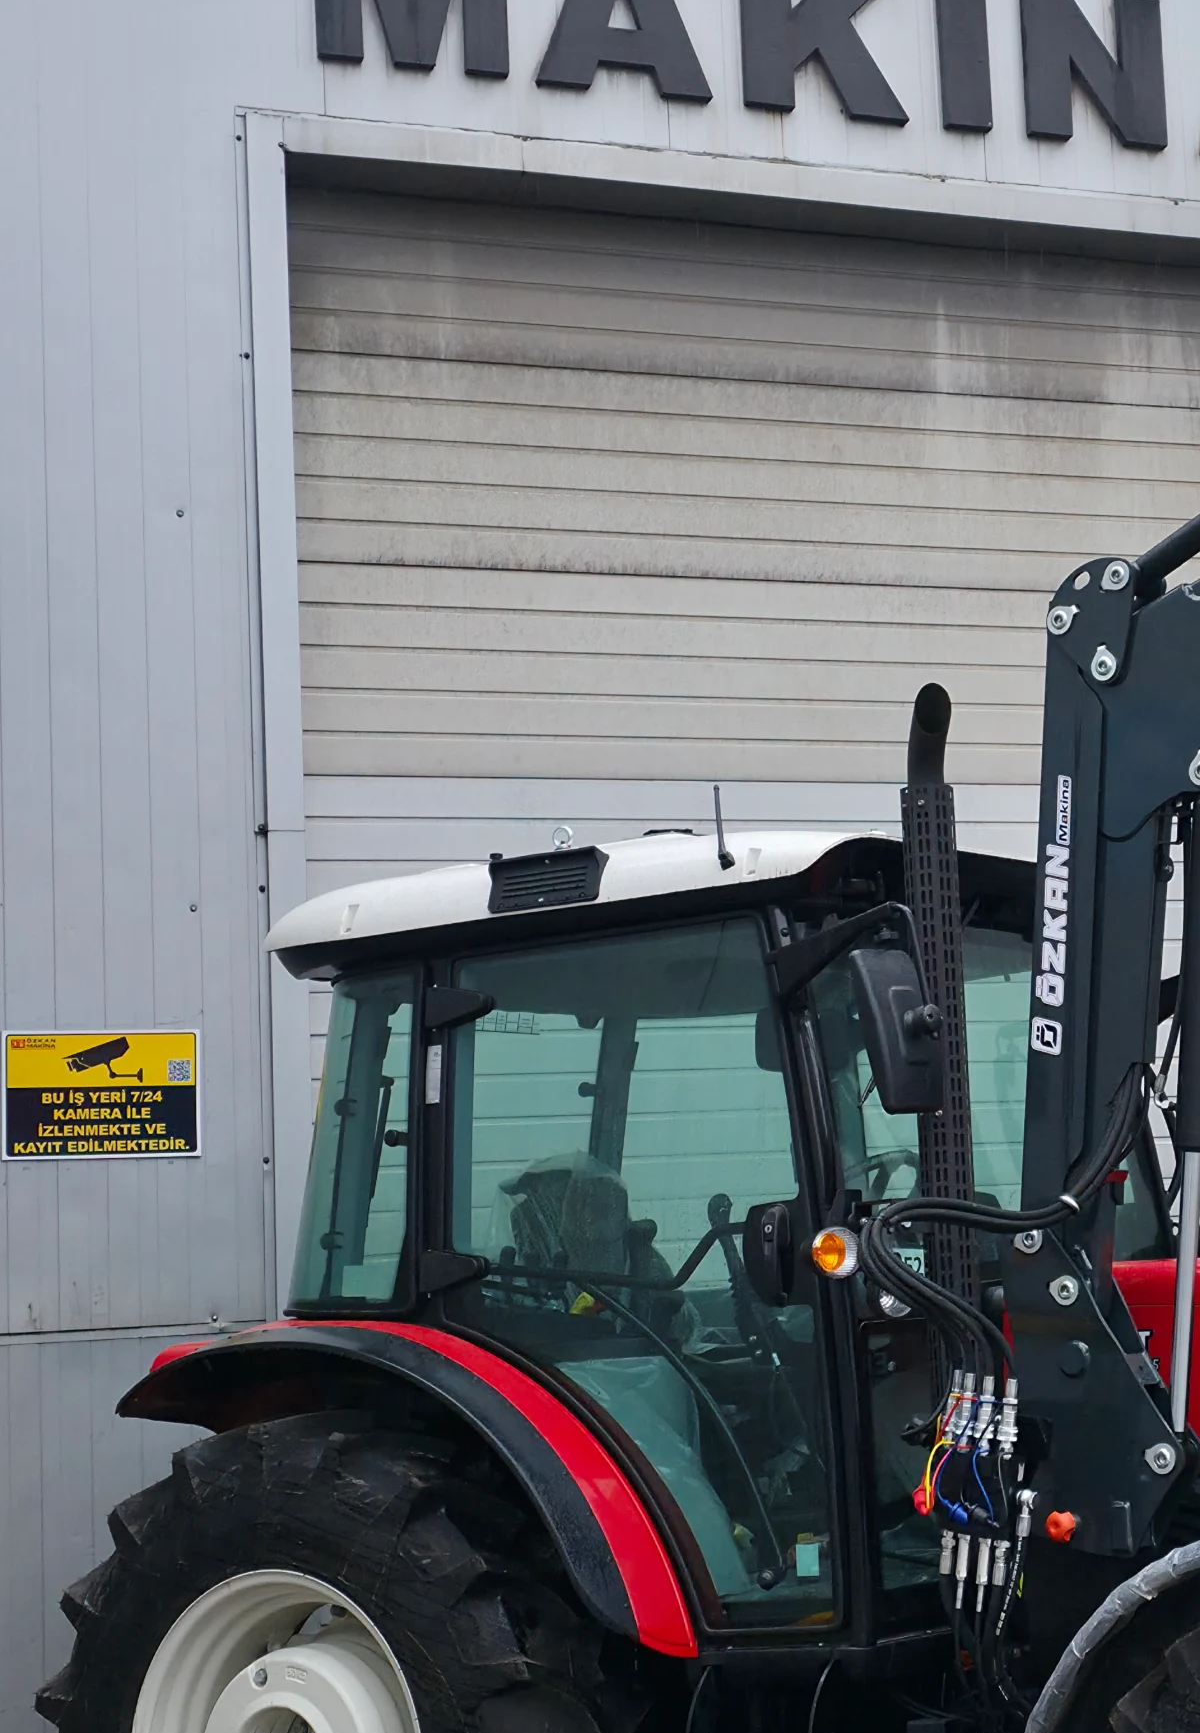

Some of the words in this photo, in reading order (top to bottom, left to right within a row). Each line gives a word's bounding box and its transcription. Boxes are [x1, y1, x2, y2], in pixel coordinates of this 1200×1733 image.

[1035, 843, 1070, 1007] ÖZKAN
[1058, 779, 1069, 842] Makina
[41, 1092, 64, 1104] BU
[69, 1089, 84, 1106] İŞ
[89, 1089, 126, 1104] YERİ
[130, 1090, 162, 1102] 7/24
[53, 1108, 122, 1120] KAMERA
[126, 1105, 151, 1118] İLE
[38, 1122, 141, 1137] İZLENMEKTE
[145, 1123, 166, 1135] VE
[13, 1141, 63, 1153] KAYIT
[67, 1136, 190, 1153] EDİLMEKTEDİR.
